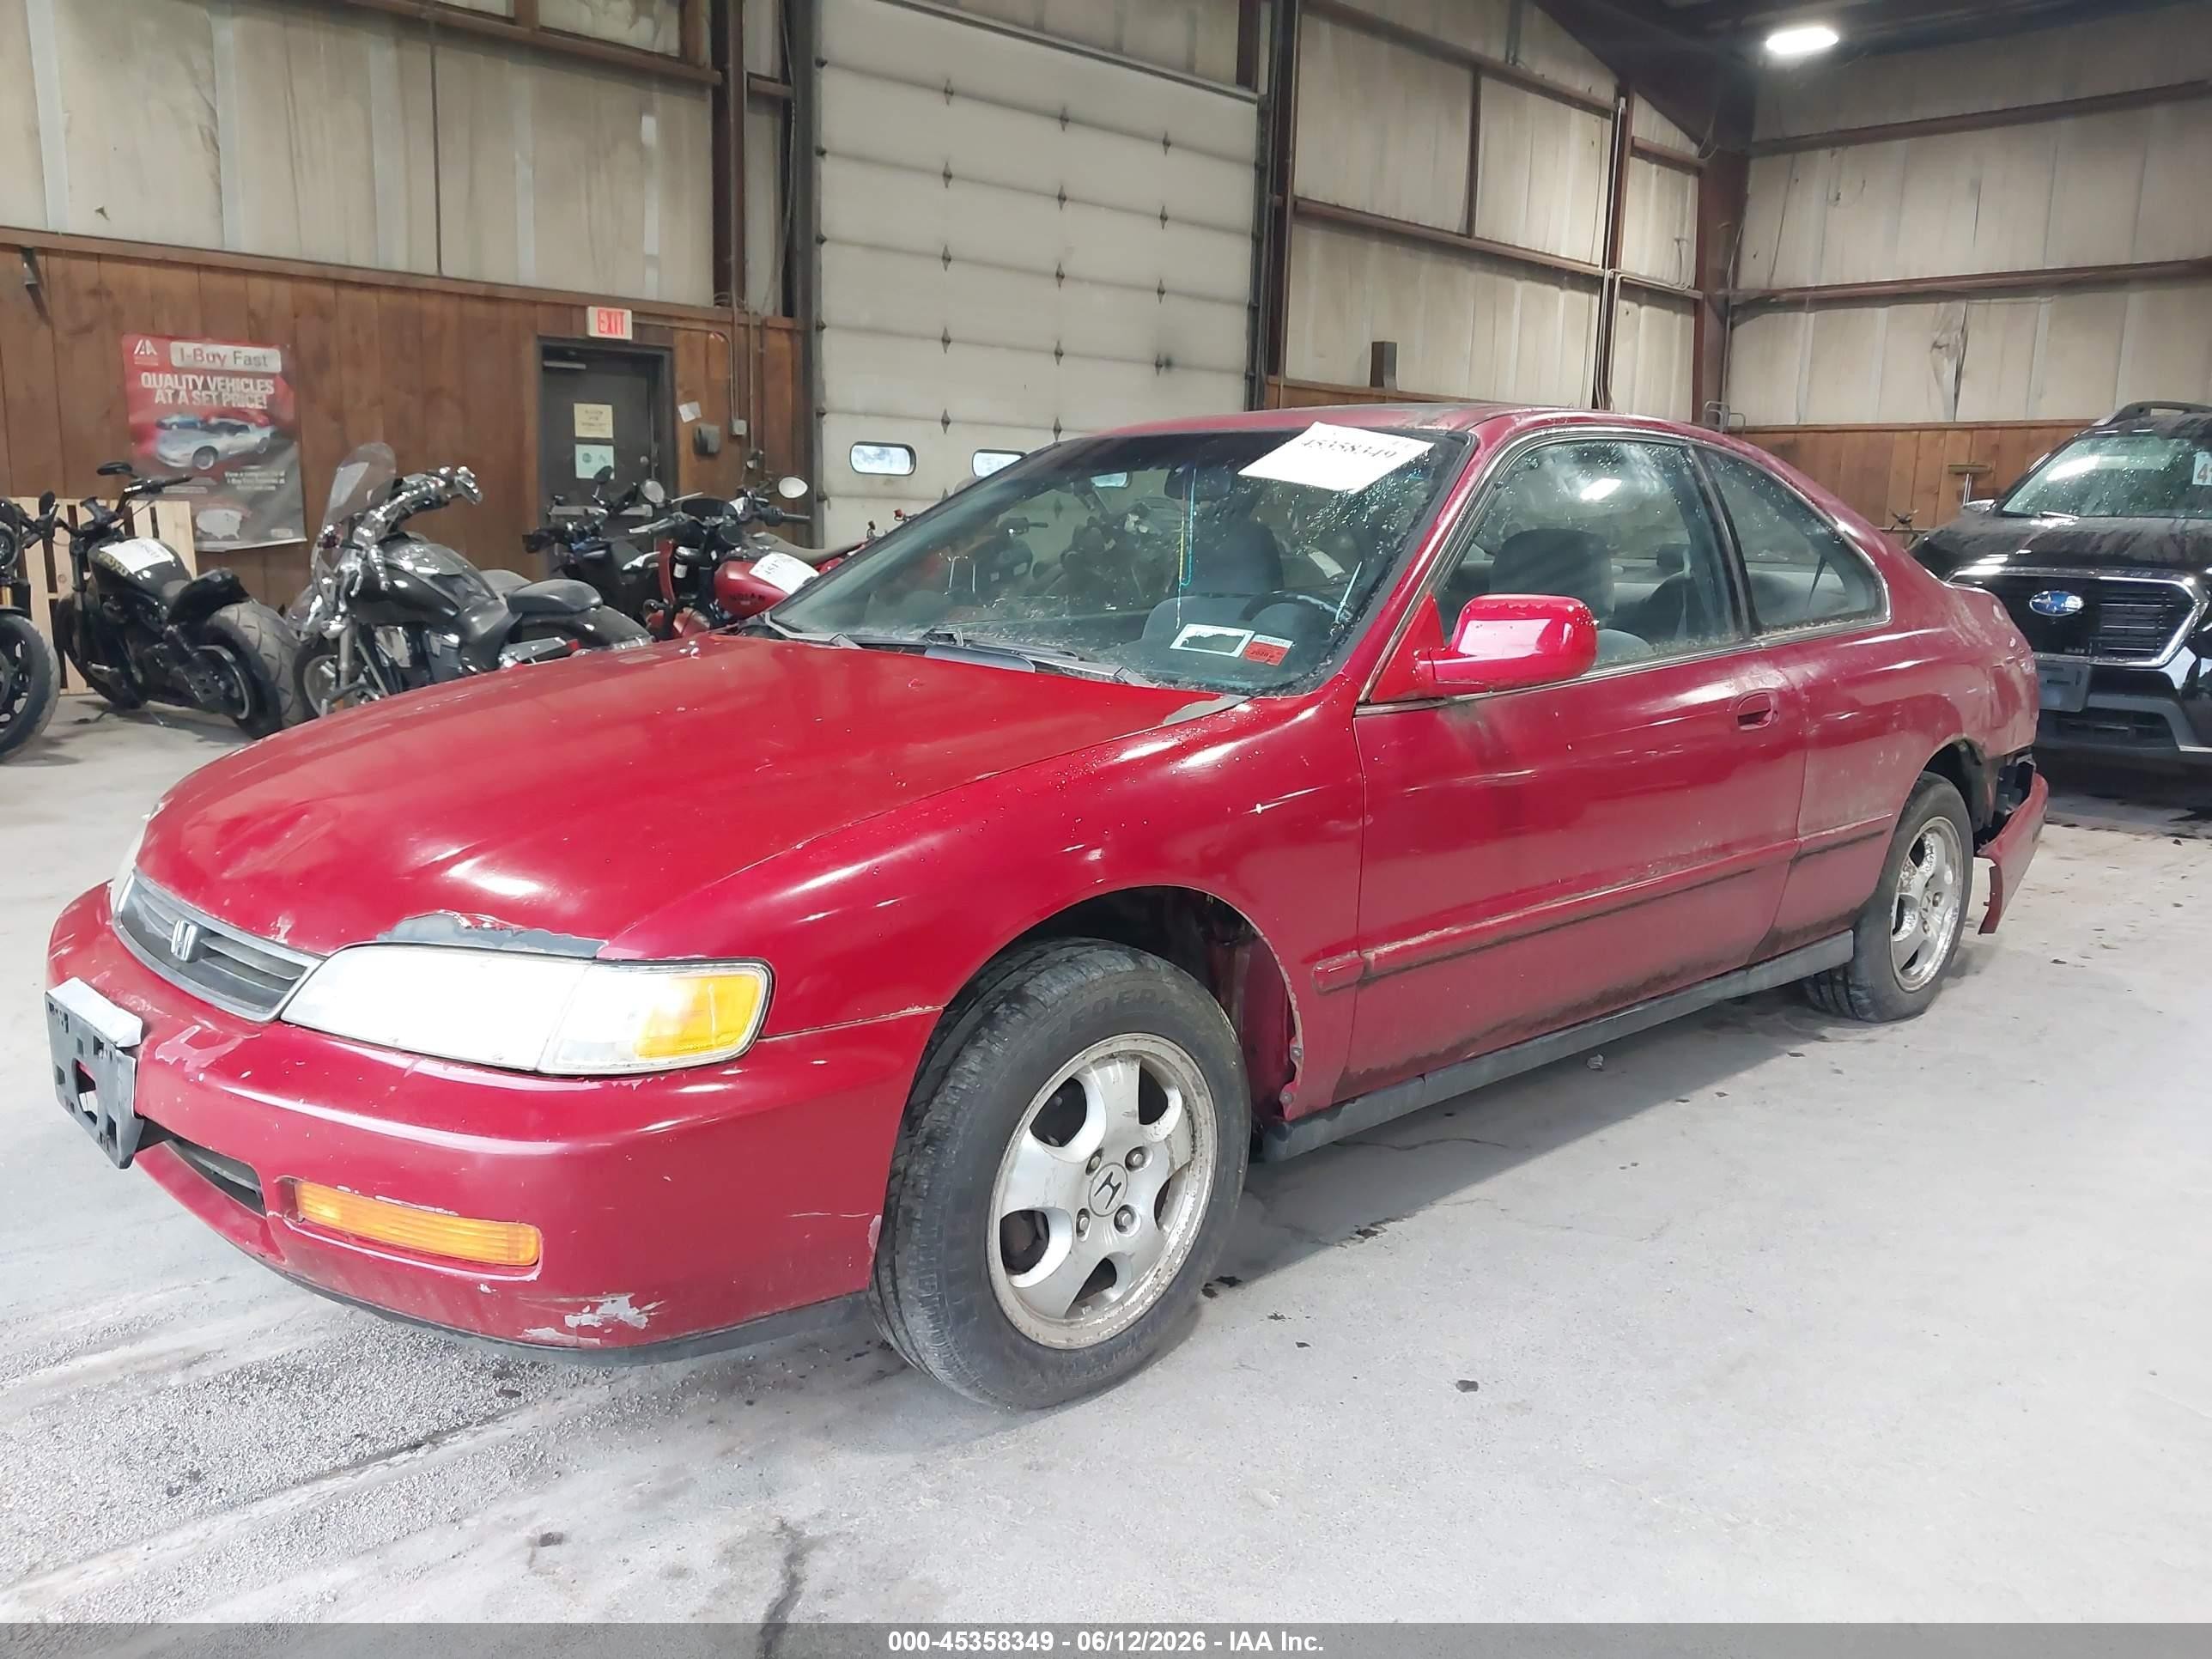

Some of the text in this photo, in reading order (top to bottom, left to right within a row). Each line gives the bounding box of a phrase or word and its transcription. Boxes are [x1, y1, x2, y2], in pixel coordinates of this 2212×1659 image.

[597, 309, 625, 335] EXIT
[180, 347, 227, 367] I-Buy
[233, 350, 269, 368] Fast
[140, 371, 275, 395] QUALITY VEHICLES
[155, 389, 268, 410] AT A SET PRICE!
